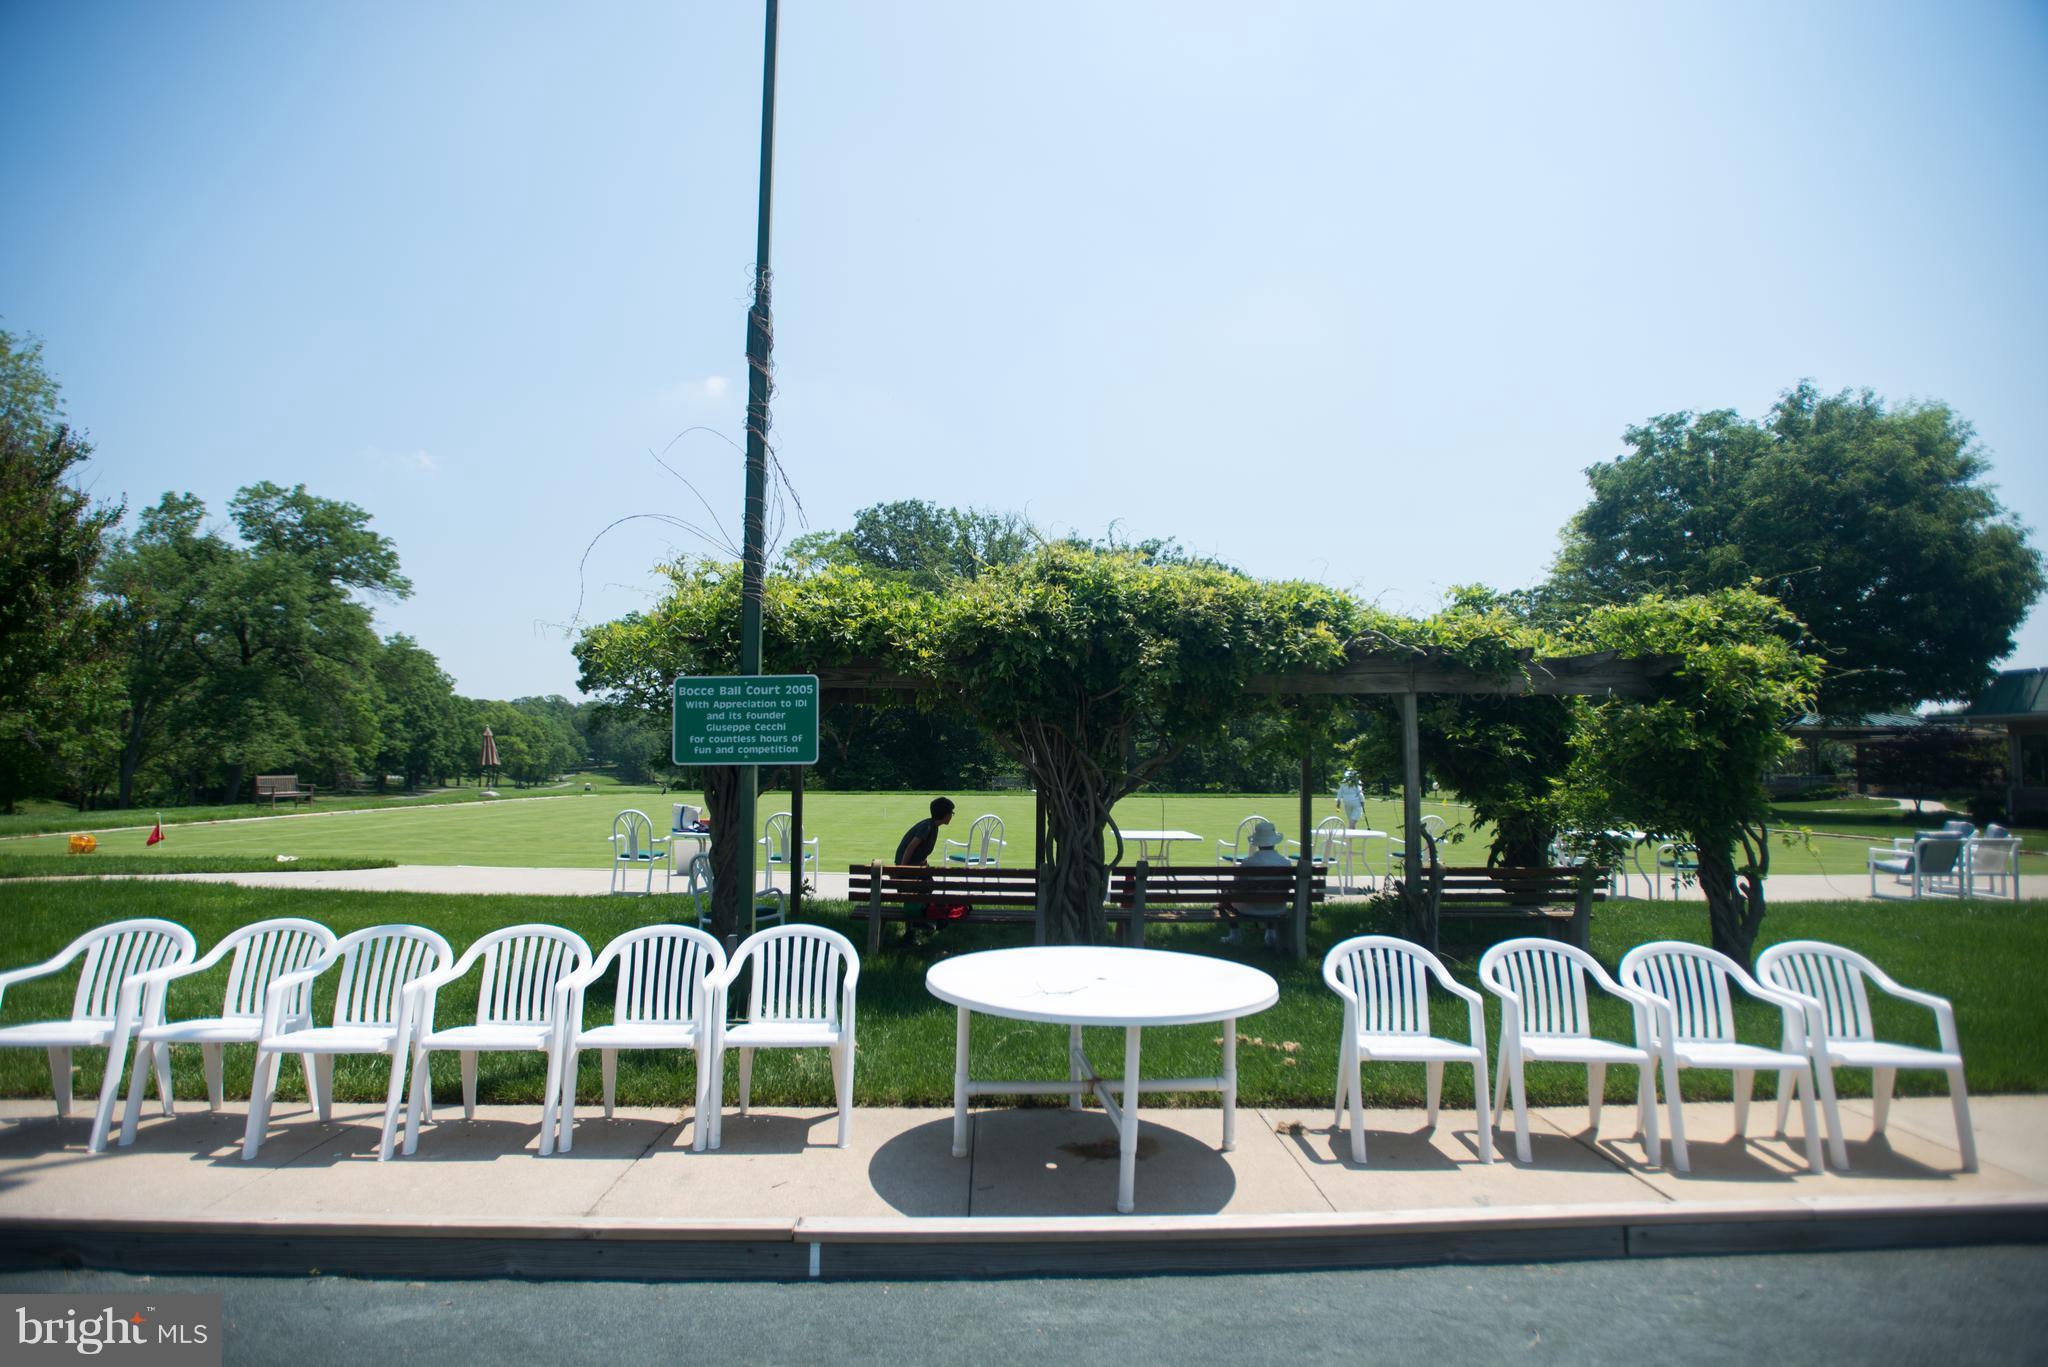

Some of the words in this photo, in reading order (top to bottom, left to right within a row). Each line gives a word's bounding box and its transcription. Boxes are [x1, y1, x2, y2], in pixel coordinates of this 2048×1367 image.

[679, 687, 714, 696] Bocce
[720, 686, 741, 695] Ball
[746, 686, 780, 695] Court
[786, 685, 813, 694] 2005
[686, 701, 709, 709] With
[713, 700, 776, 709] Appreciation
[707, 712, 724, 720] and
[729, 712, 741, 720] its
[746, 711, 786, 720] founder
[706, 724, 750, 732] Giuseppe
[755, 723, 786, 731] Cecchi
[709, 735, 756, 743] countless
[792, 734, 803, 742] of
[738, 745, 798, 755] competition
